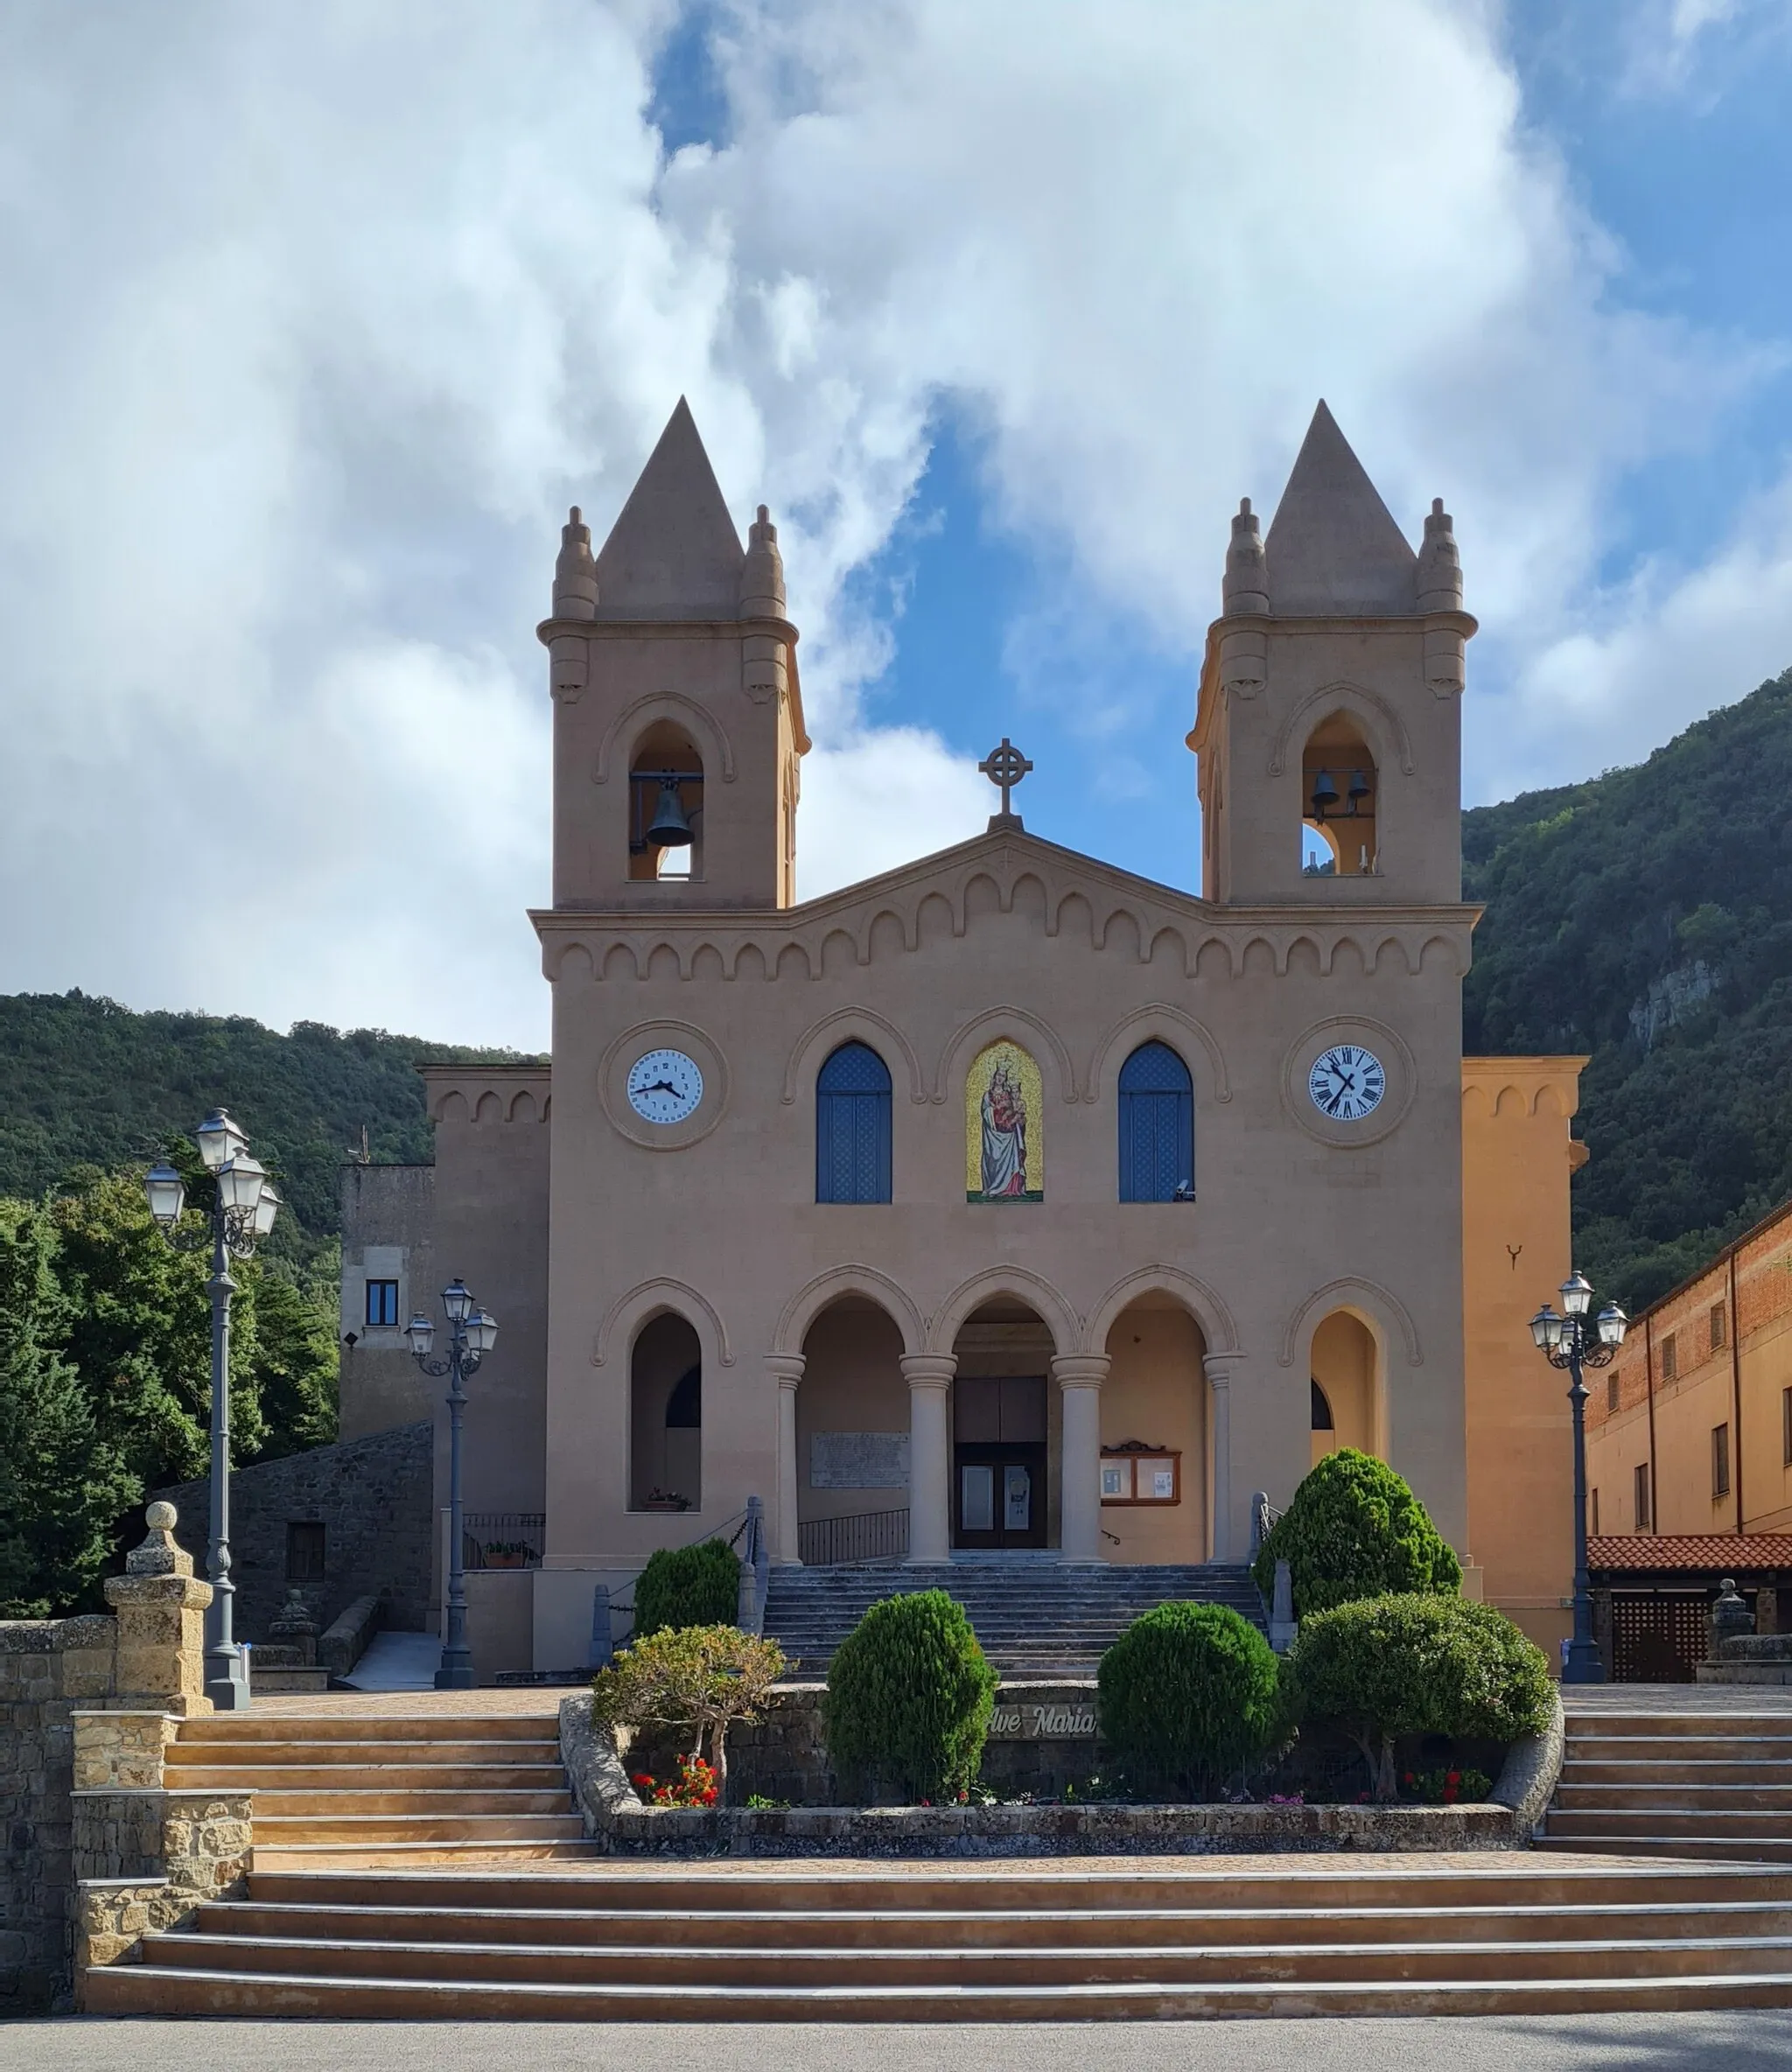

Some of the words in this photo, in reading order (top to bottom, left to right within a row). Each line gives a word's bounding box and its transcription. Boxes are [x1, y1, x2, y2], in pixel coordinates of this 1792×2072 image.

[1325, 1050, 1340, 1067] XI
[1341, 1047, 1352, 1064] XII
[1355, 1052, 1365, 1067] I
[1317, 1062, 1332, 1075] X
[1362, 1064, 1376, 1074] II
[1343, 1101, 1352, 1118] VI
[1356, 1098, 1369, 1115] V
[986, 1706, 1022, 1732] Ave
[1032, 1706, 1097, 1737] Maria
